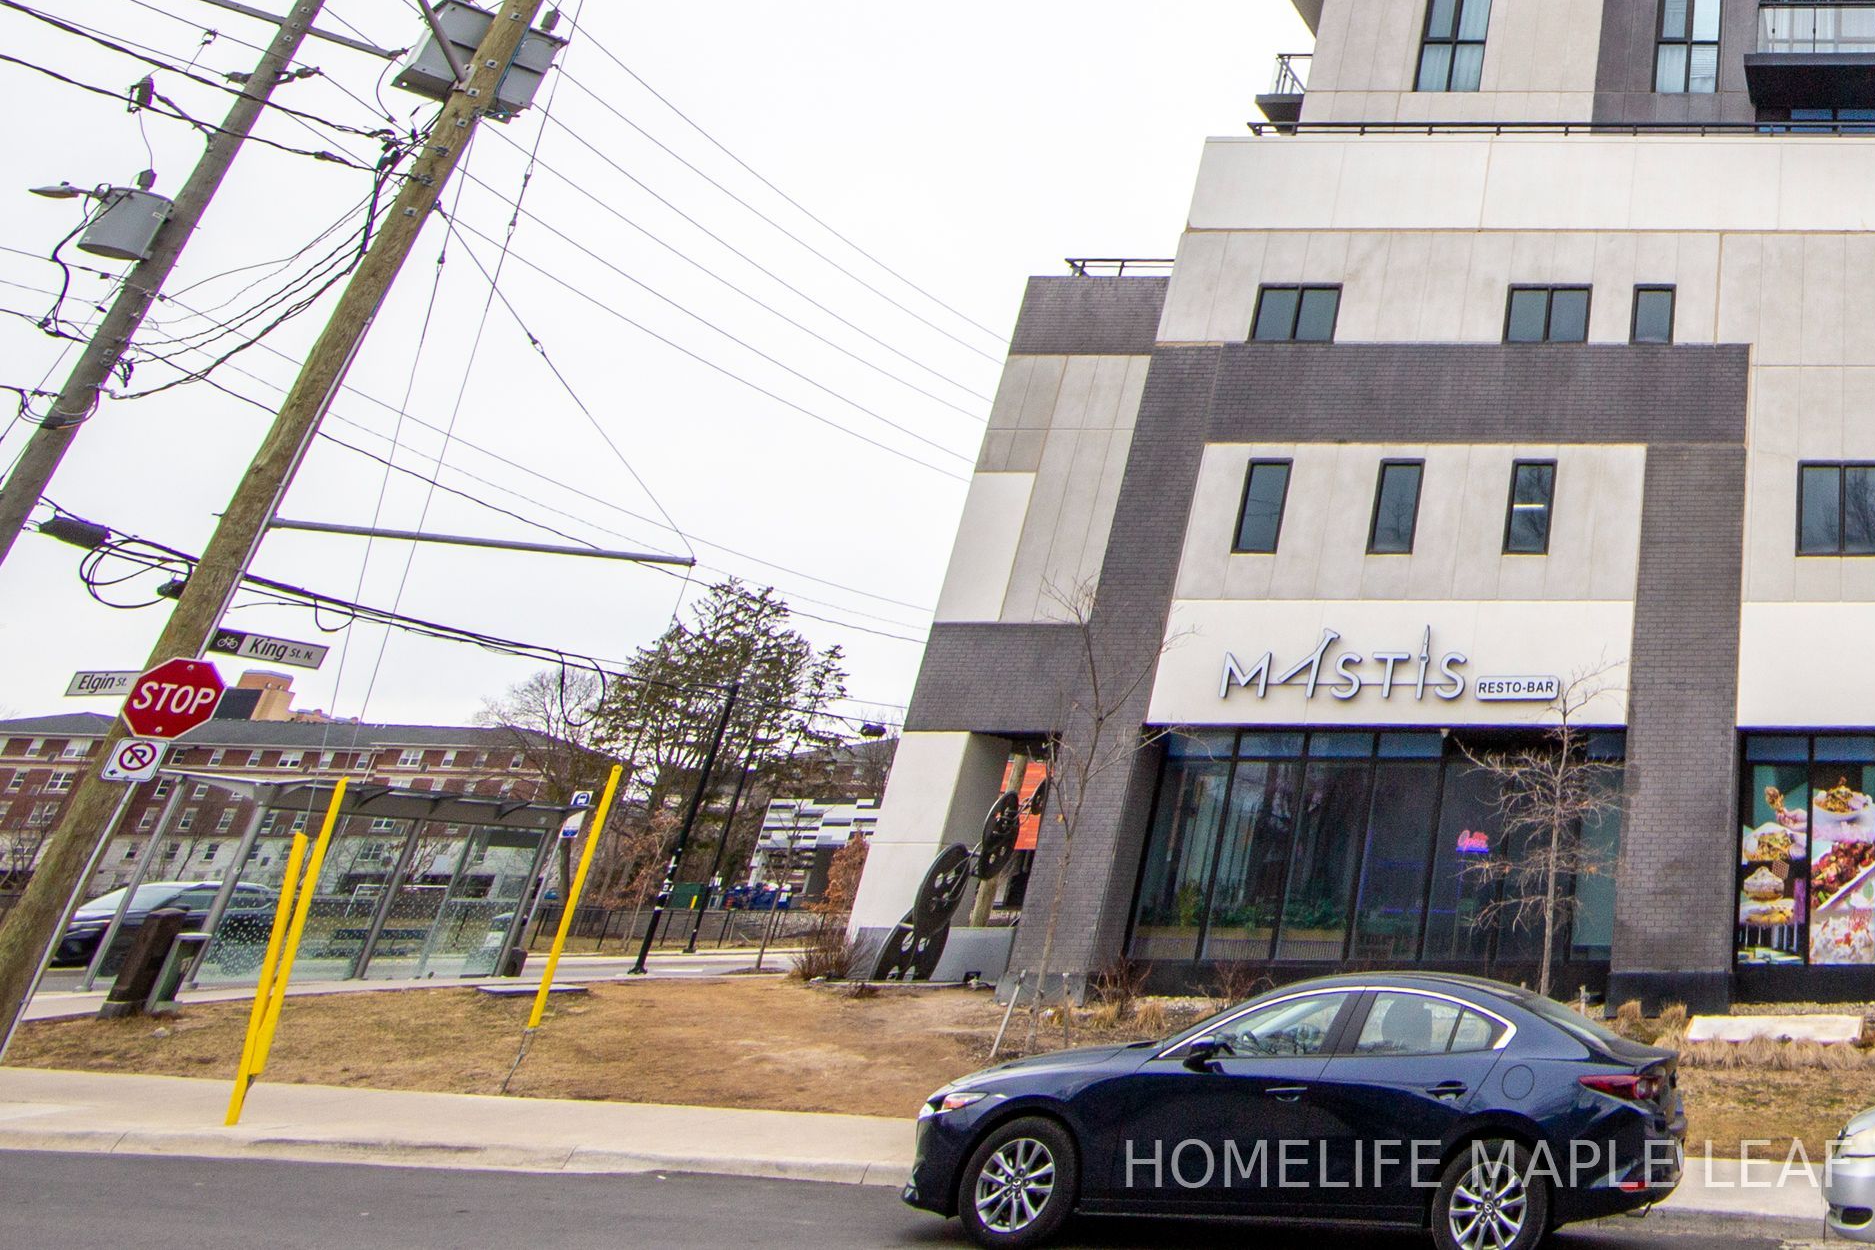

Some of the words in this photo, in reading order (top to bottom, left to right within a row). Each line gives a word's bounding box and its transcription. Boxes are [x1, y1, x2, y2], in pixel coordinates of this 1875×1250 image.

[249, 637, 289, 661] King
[1218, 624, 1467, 700] MASTIS
[78, 673, 116, 694] Elgin
[1478, 681, 1554, 694] RESTO-BAR
[132, 681, 216, 716] STOP
